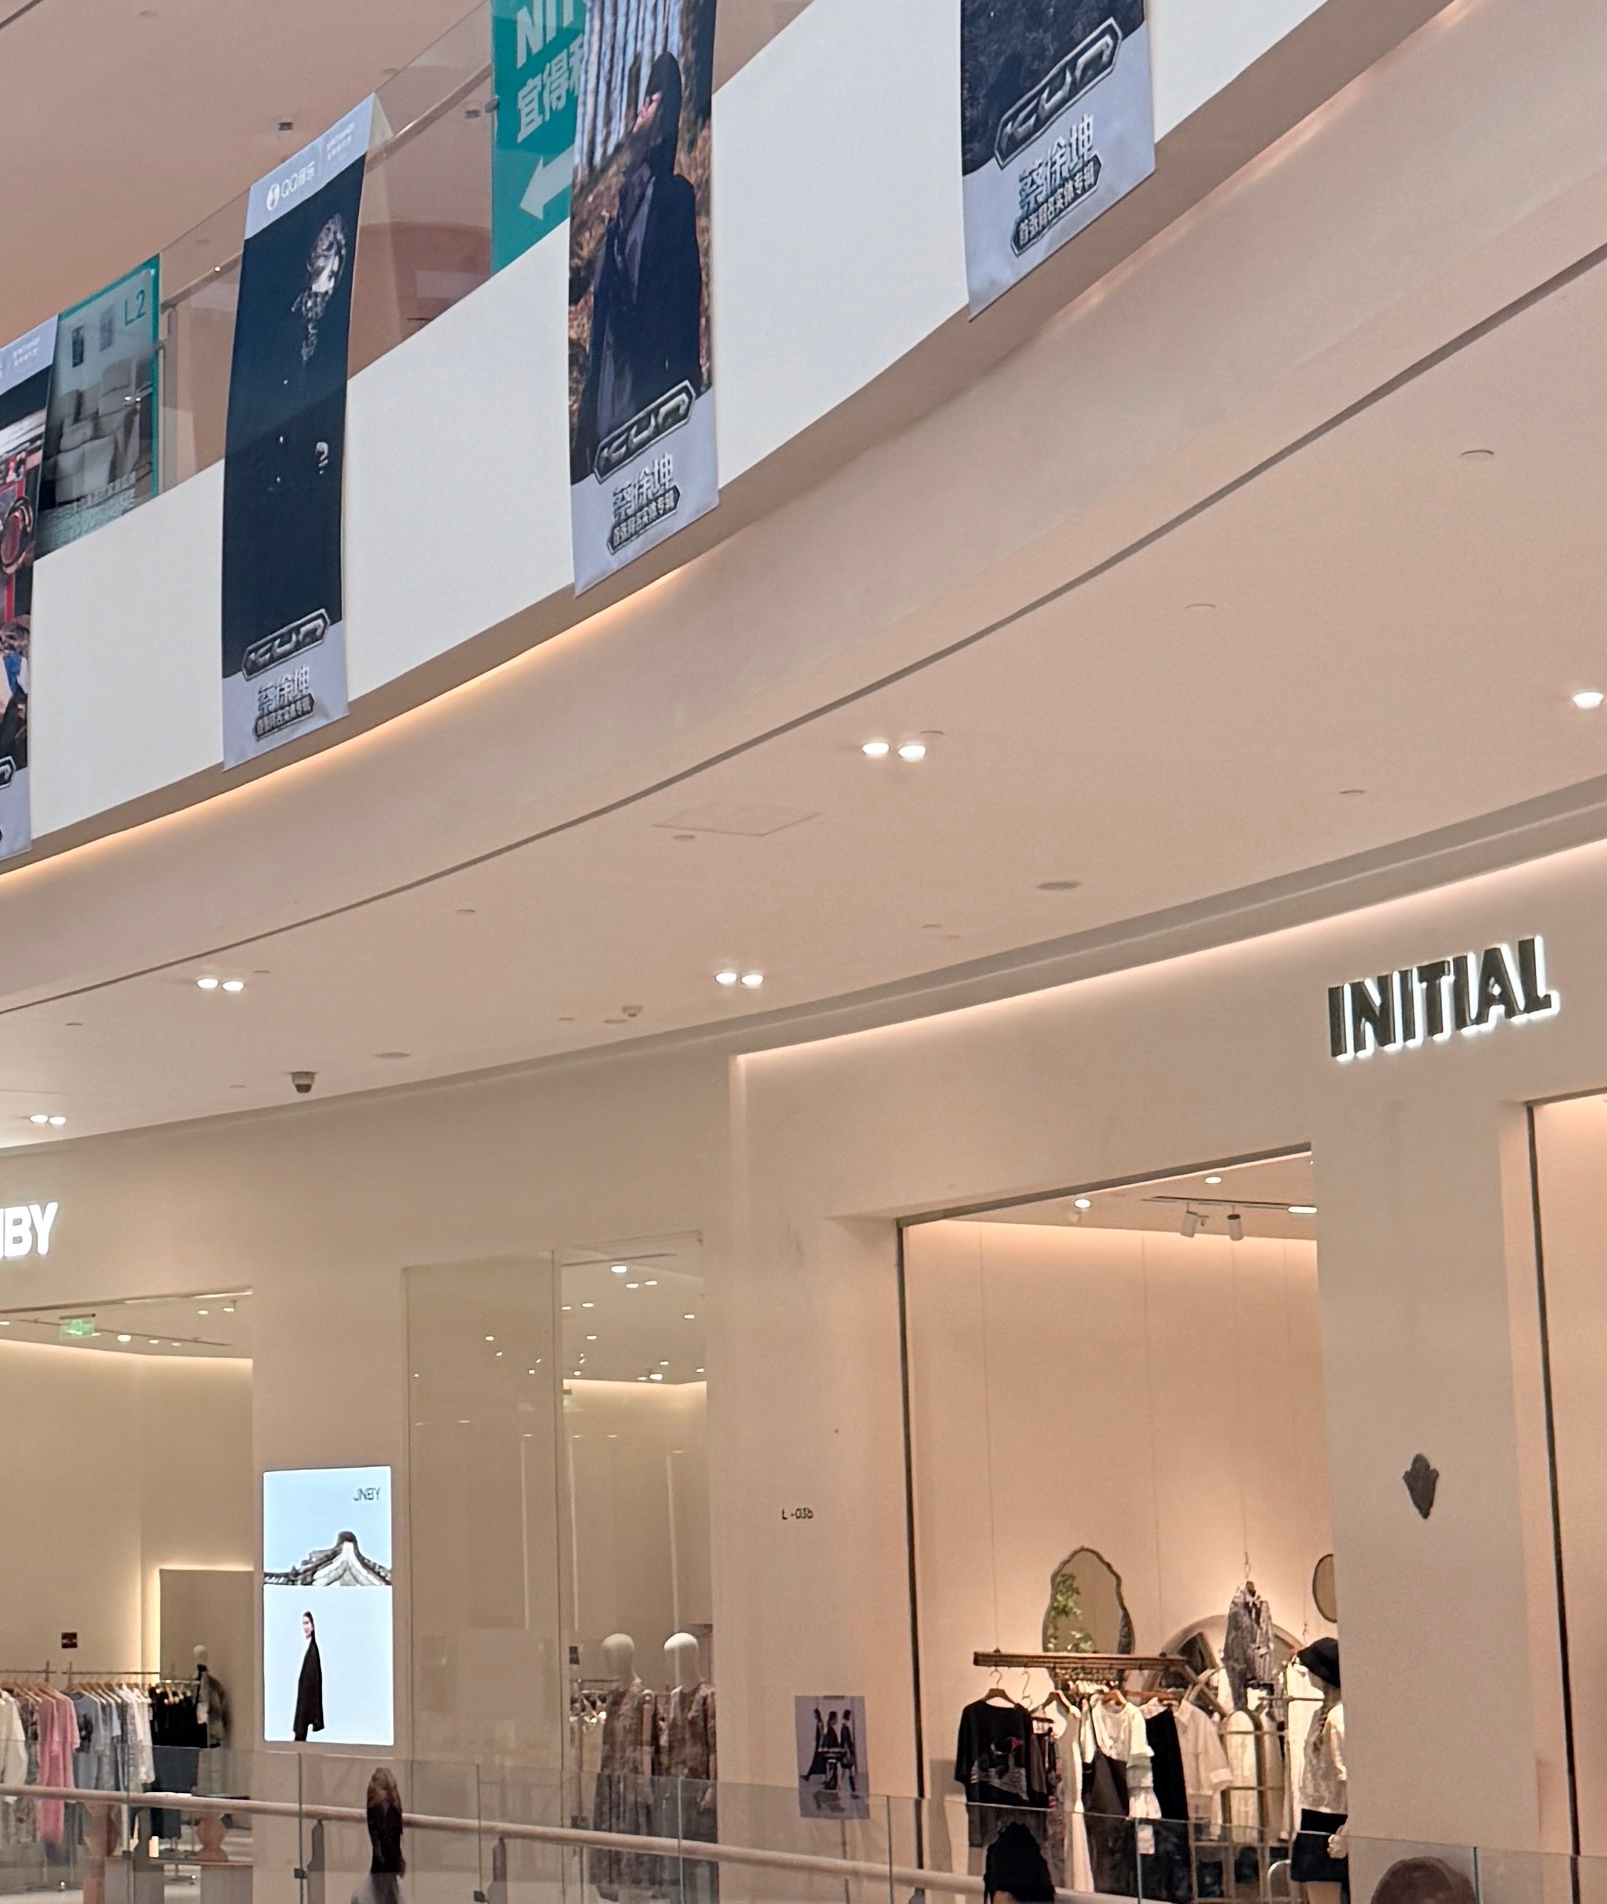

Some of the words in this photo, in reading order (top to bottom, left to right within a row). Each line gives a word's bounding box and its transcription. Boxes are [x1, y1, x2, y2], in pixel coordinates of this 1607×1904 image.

[1018, 113, 1095, 218] 蔡徐坤
[124, 288, 147, 328] L2
[1327, 935, 1561, 1062] INITIAL
[353, 1487, 382, 1502] JNBY
